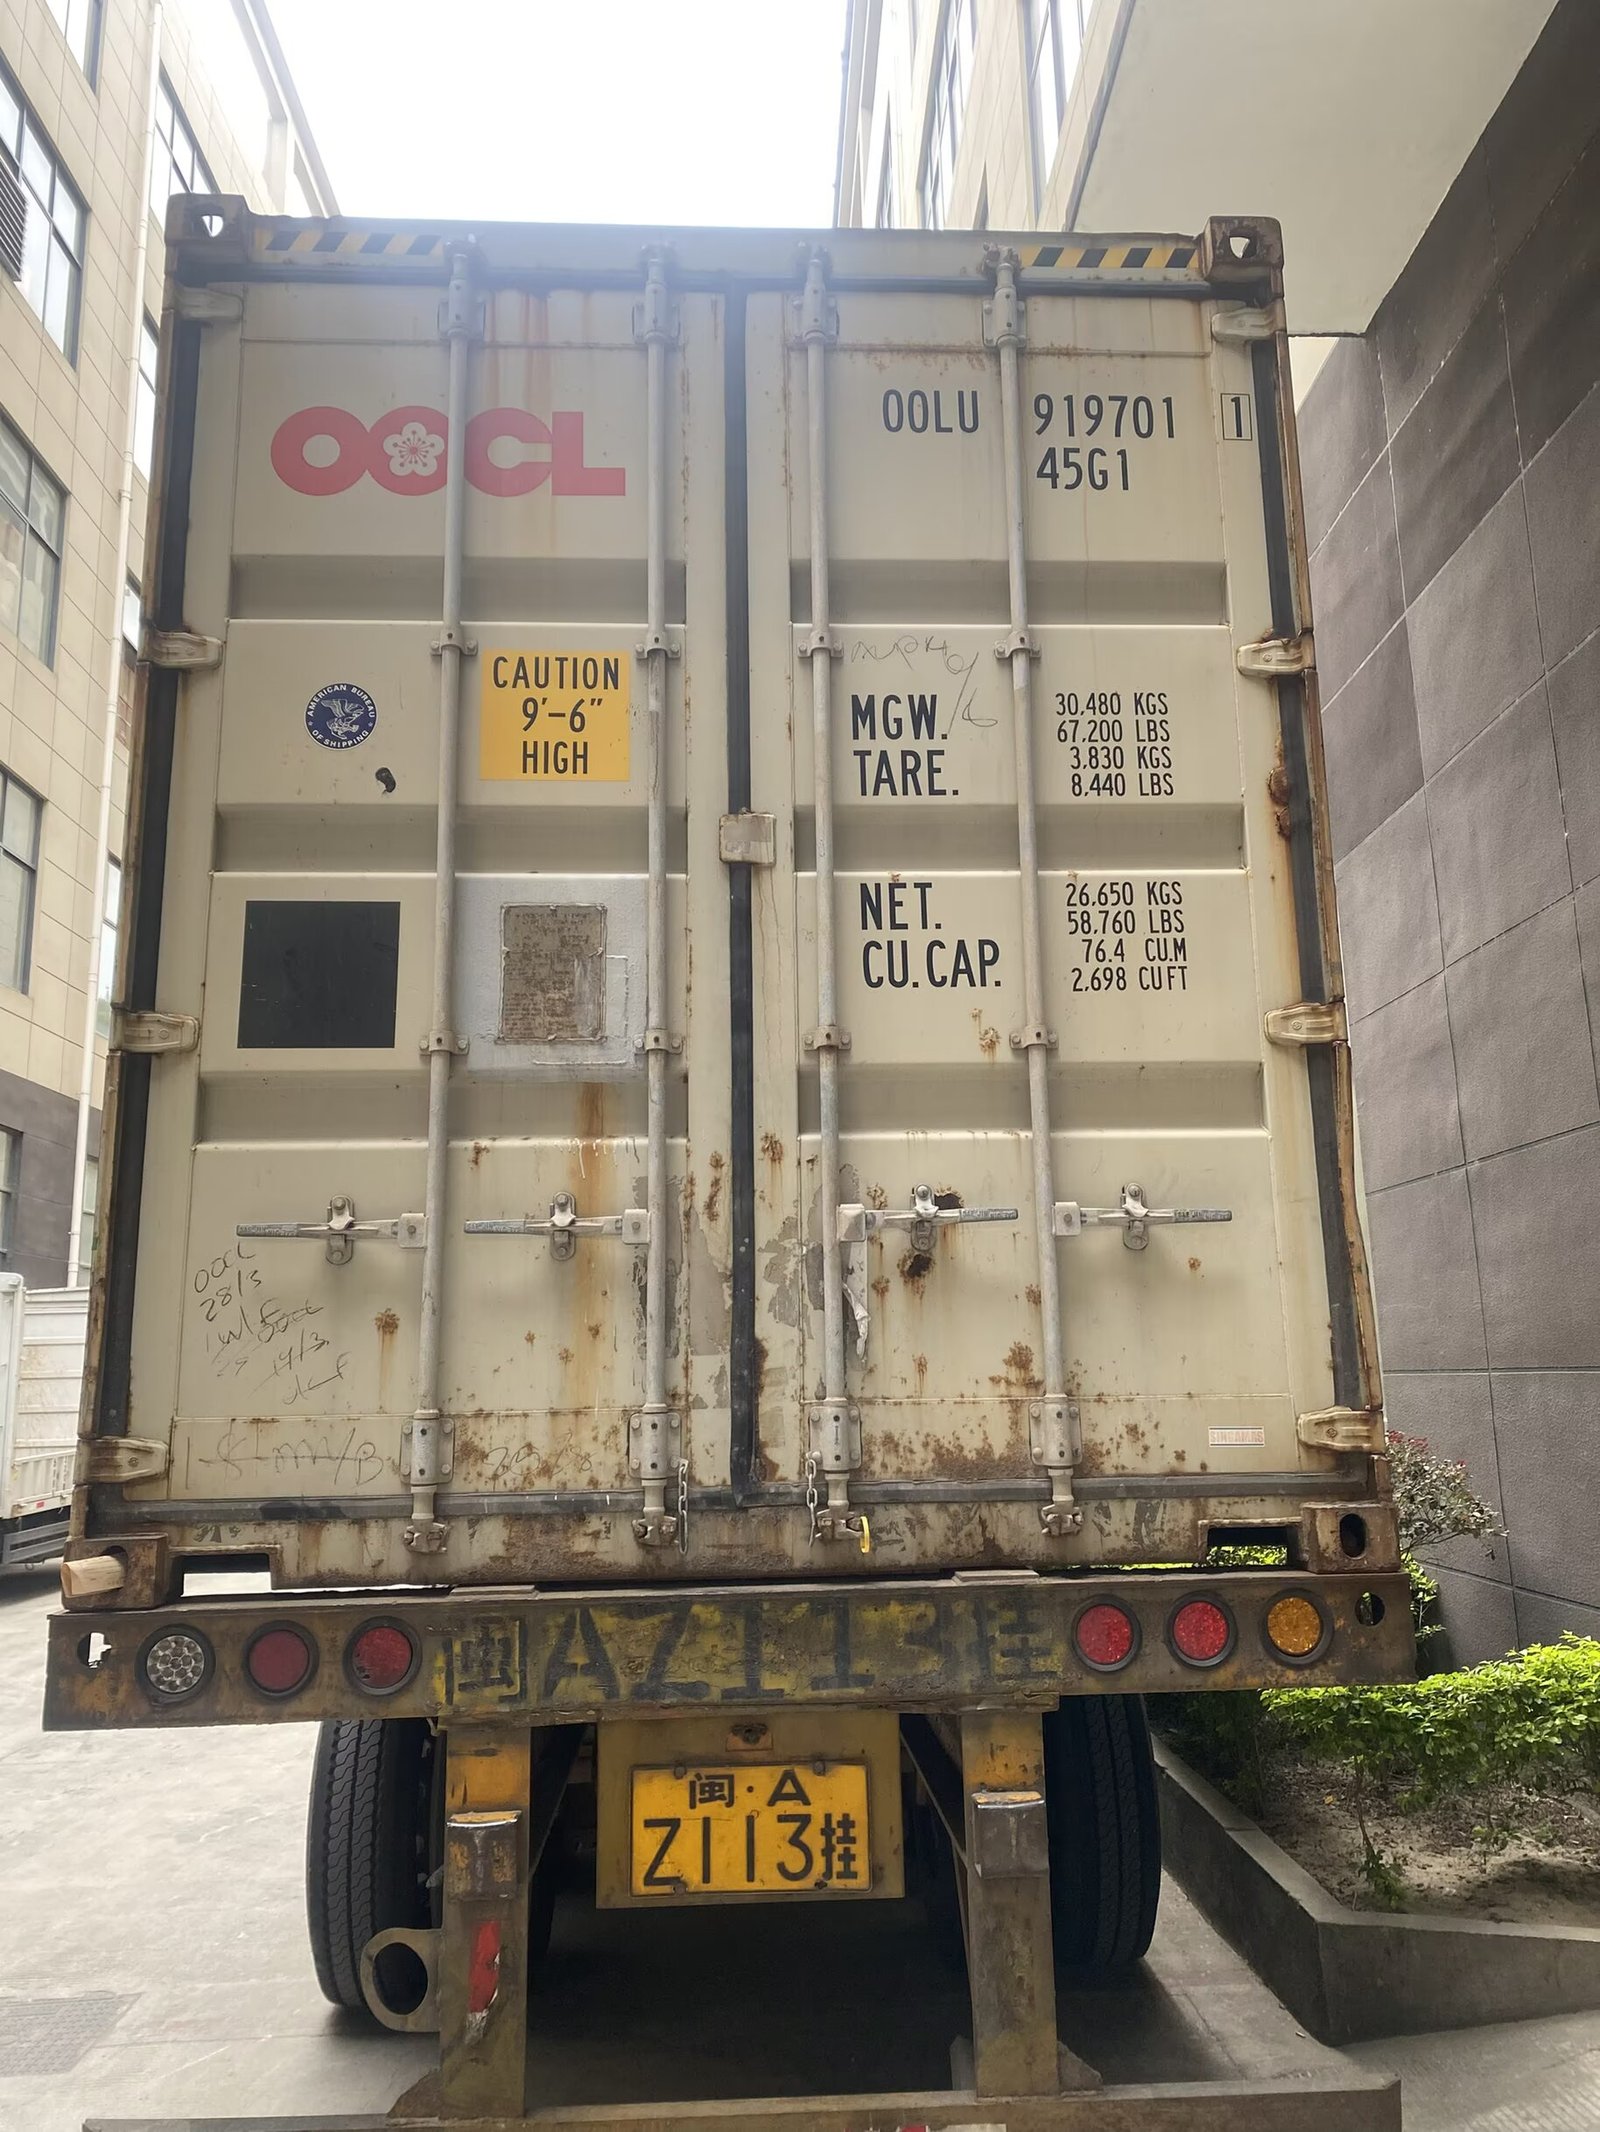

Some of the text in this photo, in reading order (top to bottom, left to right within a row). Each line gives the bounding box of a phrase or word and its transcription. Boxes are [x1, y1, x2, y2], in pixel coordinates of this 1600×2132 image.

[882, 389, 1242, 438] OOLU 919701 1
[270, 405, 626, 497] OOCL
[1036, 446, 1128, 490] 45G1
[493, 656, 618, 689] CAUTION
[307, 684, 375, 718] AMERICAN BUREAU
[851, 694, 947, 740] MGW.
[1055, 692, 1168, 715] 30,480 KGS
[312, 729, 369, 748] OF SHIPPING
[1057, 719, 1169, 742] 67,200 LBS
[522, 740, 587, 774] HIGH
[852, 749, 958, 796] TARE.
[1069, 745, 1171, 769] 3,830 KGS
[1071, 772, 1173, 796] 8,440 LBS
[859, 881, 942, 930] NET.
[1065, 881, 1182, 906] 26,650 KGS
[1067, 909, 1184, 934] 58,760 LBS
[1081, 937, 1186, 962] 76.4 CU.M
[1071, 966, 1126, 991] 2,698
[643, 1812, 858, 1887] Z113挂
